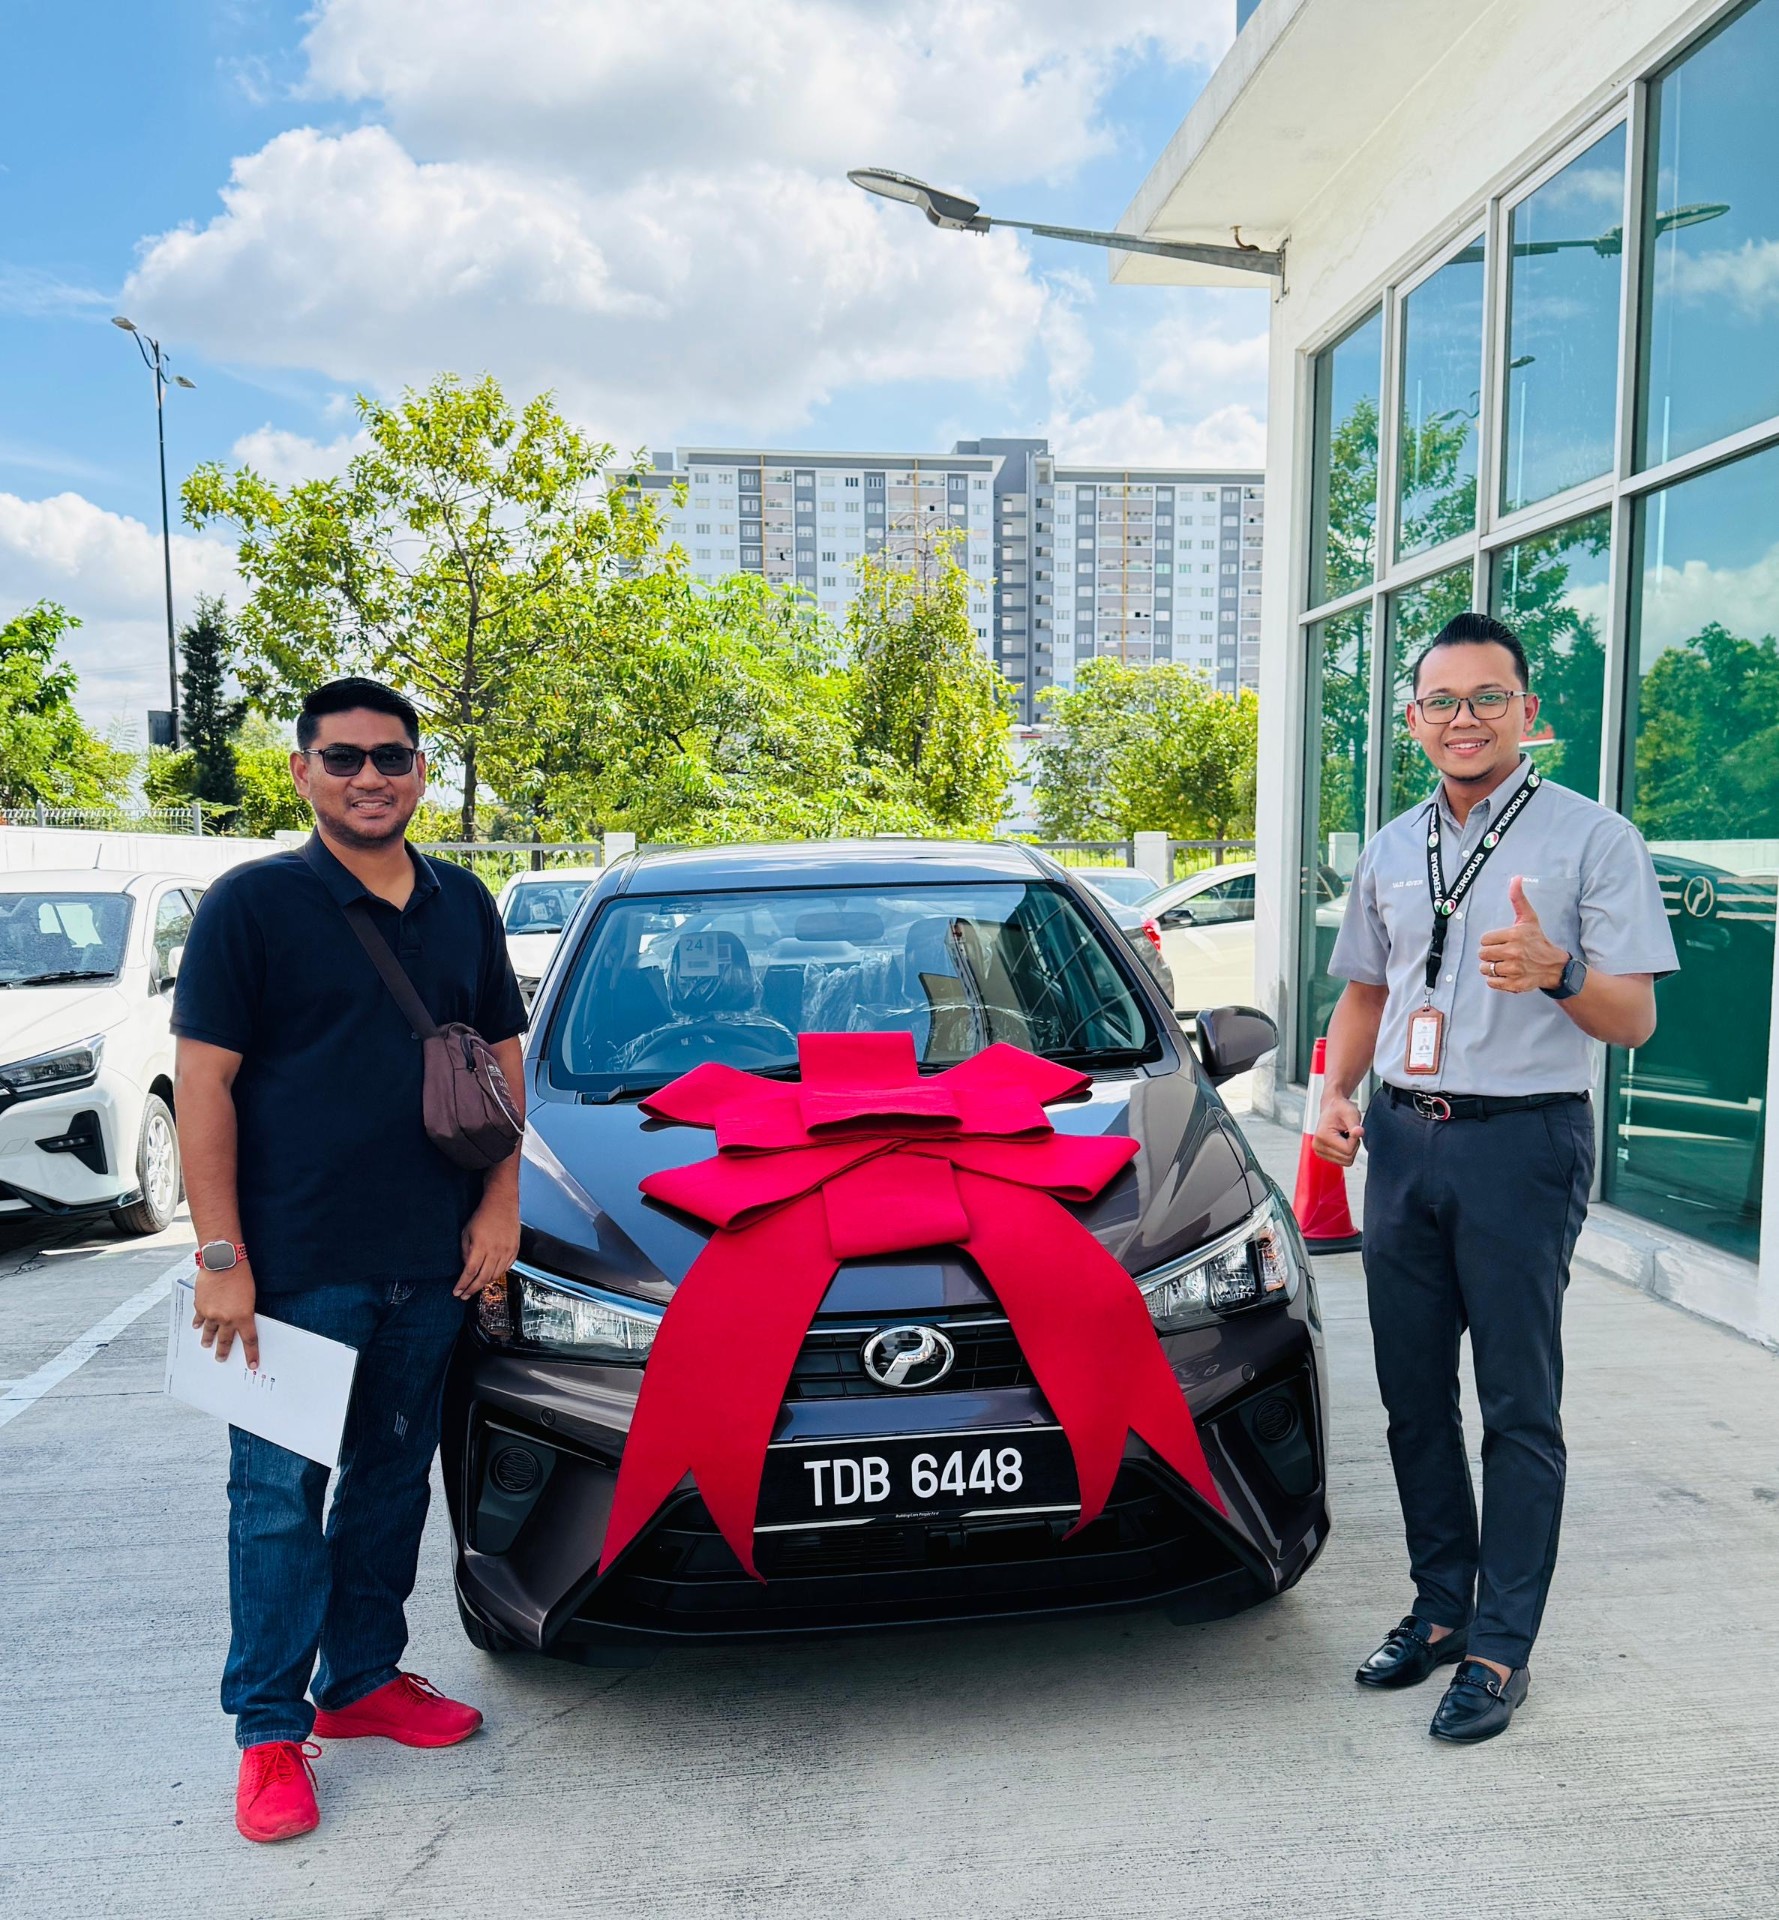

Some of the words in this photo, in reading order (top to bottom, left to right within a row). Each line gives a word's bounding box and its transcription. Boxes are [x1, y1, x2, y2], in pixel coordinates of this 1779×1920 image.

[685, 938, 703, 951] 24
[803, 1456, 891, 1506] TDB
[911, 1447, 1023, 1499] 6448
